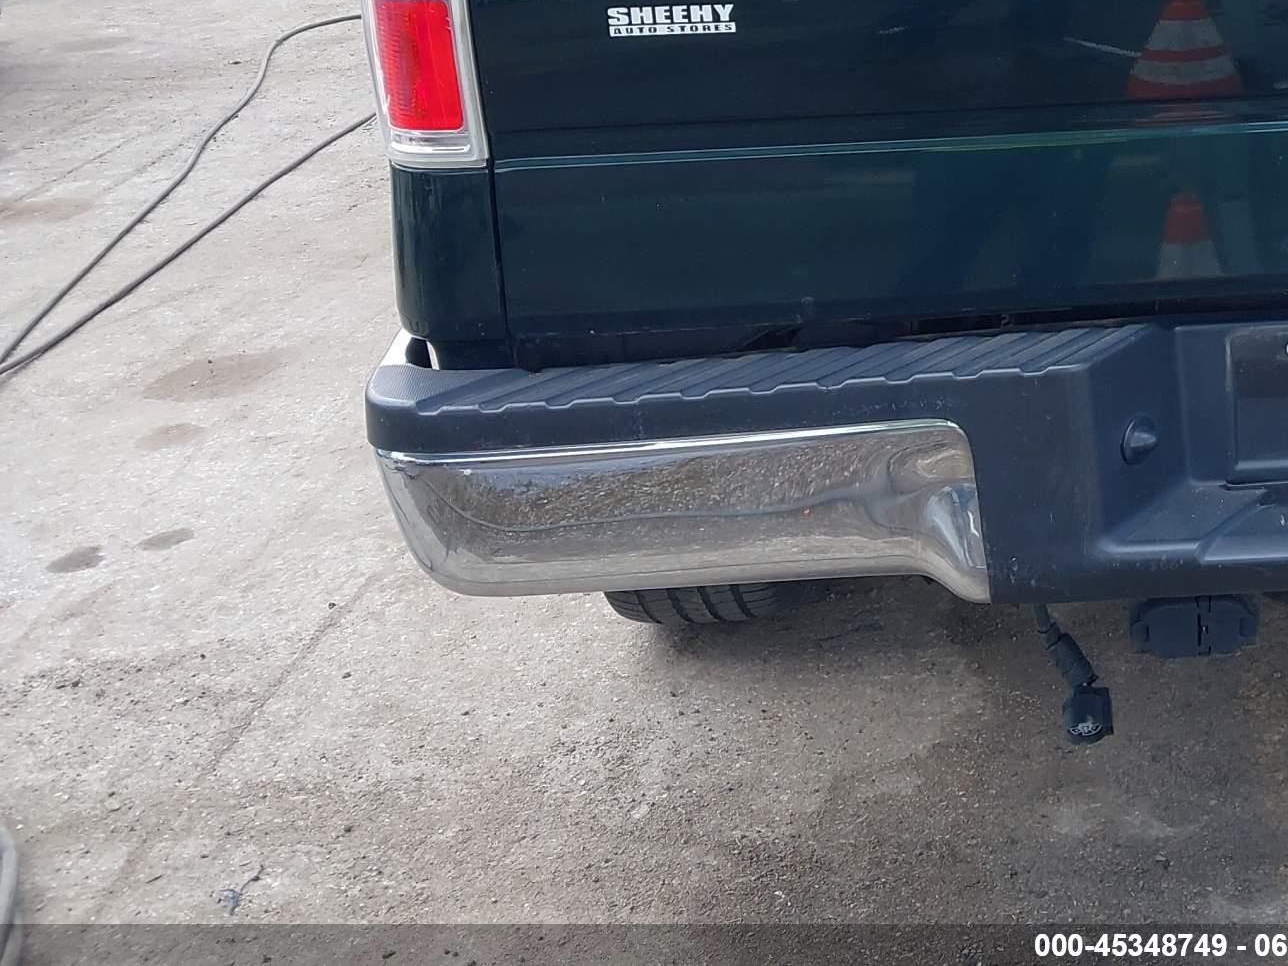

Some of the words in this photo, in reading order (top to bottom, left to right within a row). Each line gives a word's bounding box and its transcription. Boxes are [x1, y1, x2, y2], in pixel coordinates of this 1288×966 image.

[607, 4, 734, 25] SHEEHY
[612, 26, 658, 35] AUTO
[666, 24, 733, 33] STORES
